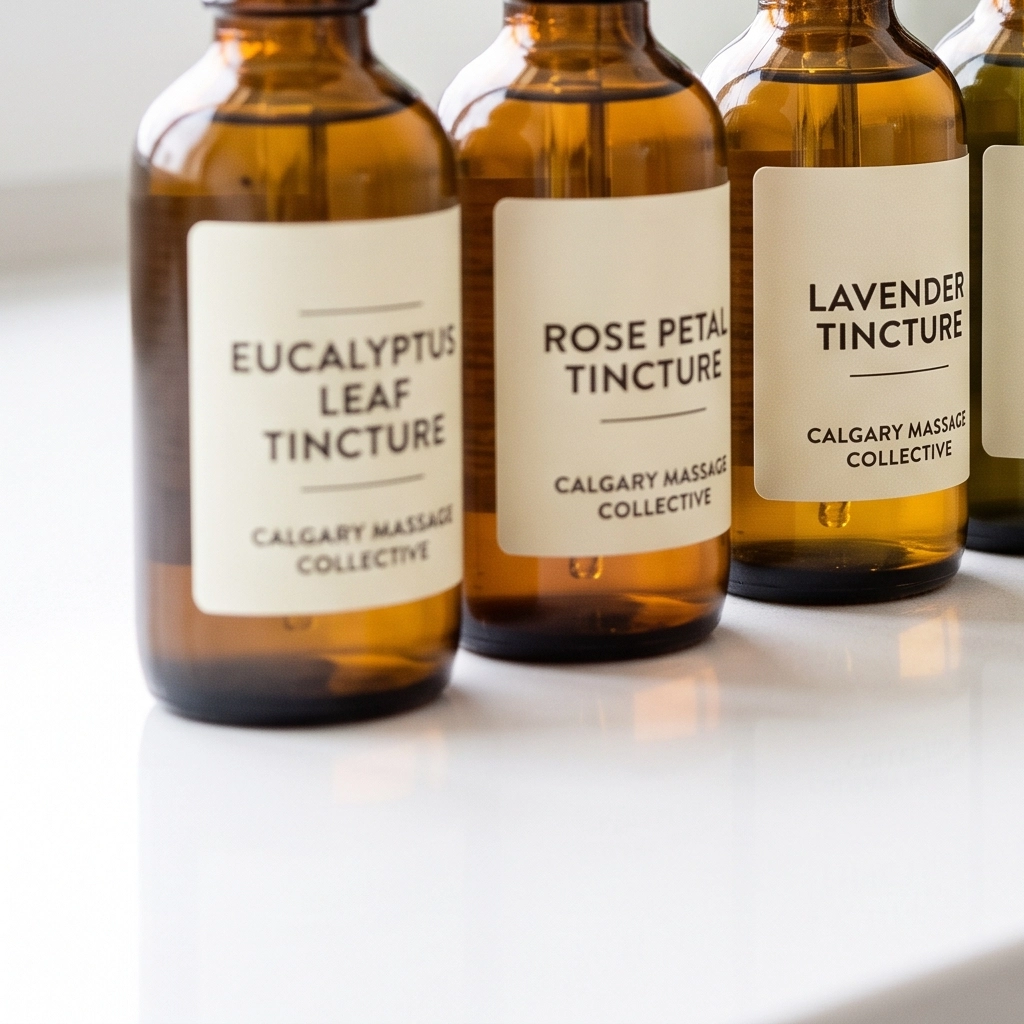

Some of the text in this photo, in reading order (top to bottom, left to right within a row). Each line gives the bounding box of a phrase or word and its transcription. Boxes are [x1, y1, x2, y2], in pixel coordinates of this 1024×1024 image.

[809, 271, 965, 312] LAVENDER
[231, 324, 456, 373] EUCALYPTUS
[544, 306, 728, 353] ROSE PETAL
[816, 309, 962, 350] TINCTURE
[565, 349, 722, 394] TINCTURE
[320, 377, 411, 416] LEAF
[264, 413, 446, 461] TINCTURE
[807, 409, 966, 444] CALGARY MASSAGE
[554, 454, 727, 494] CALGARY MASSAGE
[846, 439, 952, 468] COLLECTIVE
[598, 487, 712, 519] COLLECTIVE
[251, 504, 454, 548] CALGARY MASSAGE
[296, 540, 430, 575] COLLECTIVE
